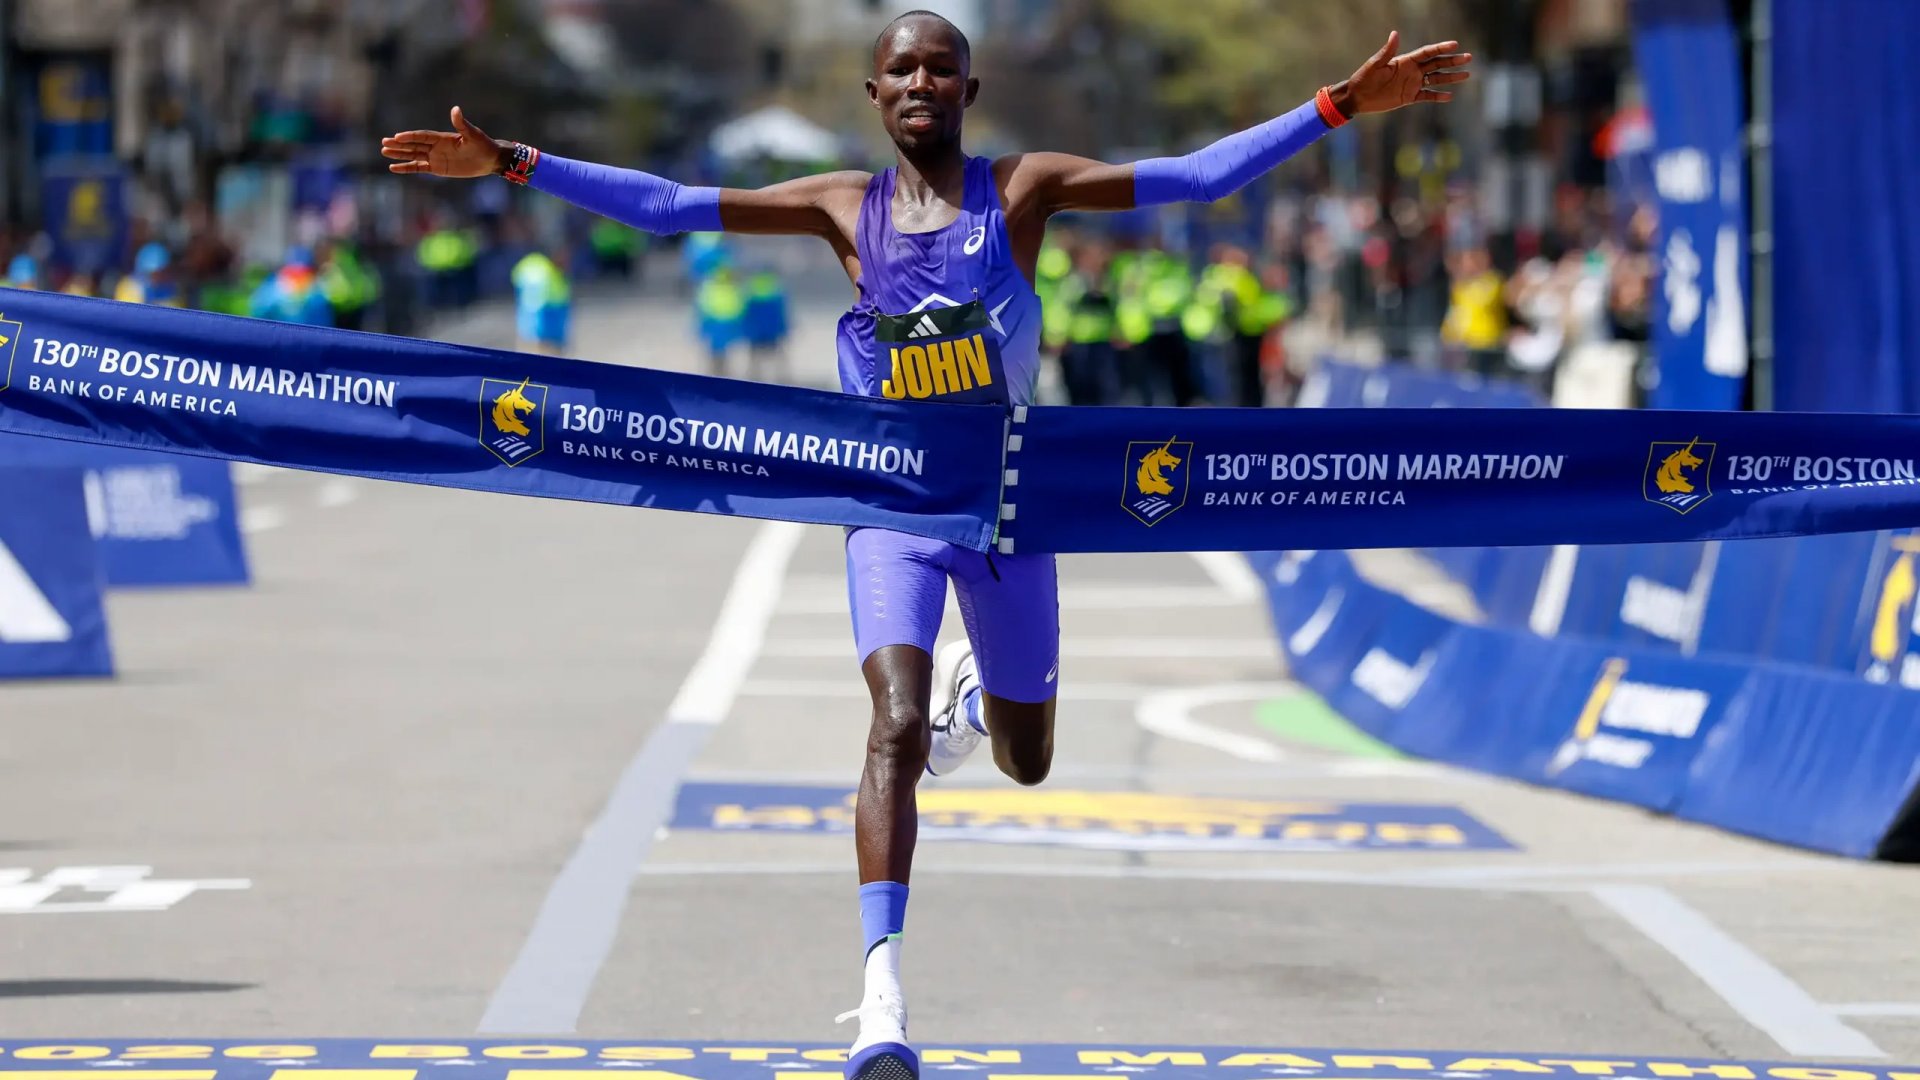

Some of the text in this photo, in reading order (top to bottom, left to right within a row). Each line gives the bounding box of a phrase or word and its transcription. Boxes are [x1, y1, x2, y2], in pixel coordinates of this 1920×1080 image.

[99, 348, 221, 387] BOSTON
[229, 363, 395, 408] MARATHON
[882, 333, 992, 399] JOHN
[29, 375, 237, 417] BANK OF AMERICA
[562, 441, 770, 477] BANK OF AMERICA
[626, 414, 746, 453] BOSTON
[753, 428, 924, 476] MARATHON
[1271, 453, 1388, 481] BOSTON
[1397, 454, 1564, 480] MARATHON
[1793, 456, 1915, 481] BOSTON
[1203, 490, 1407, 507] BANK OF AMERICA
[1730, 485, 1796, 495] BANK
[0, 1045, 318, 1060] 026
